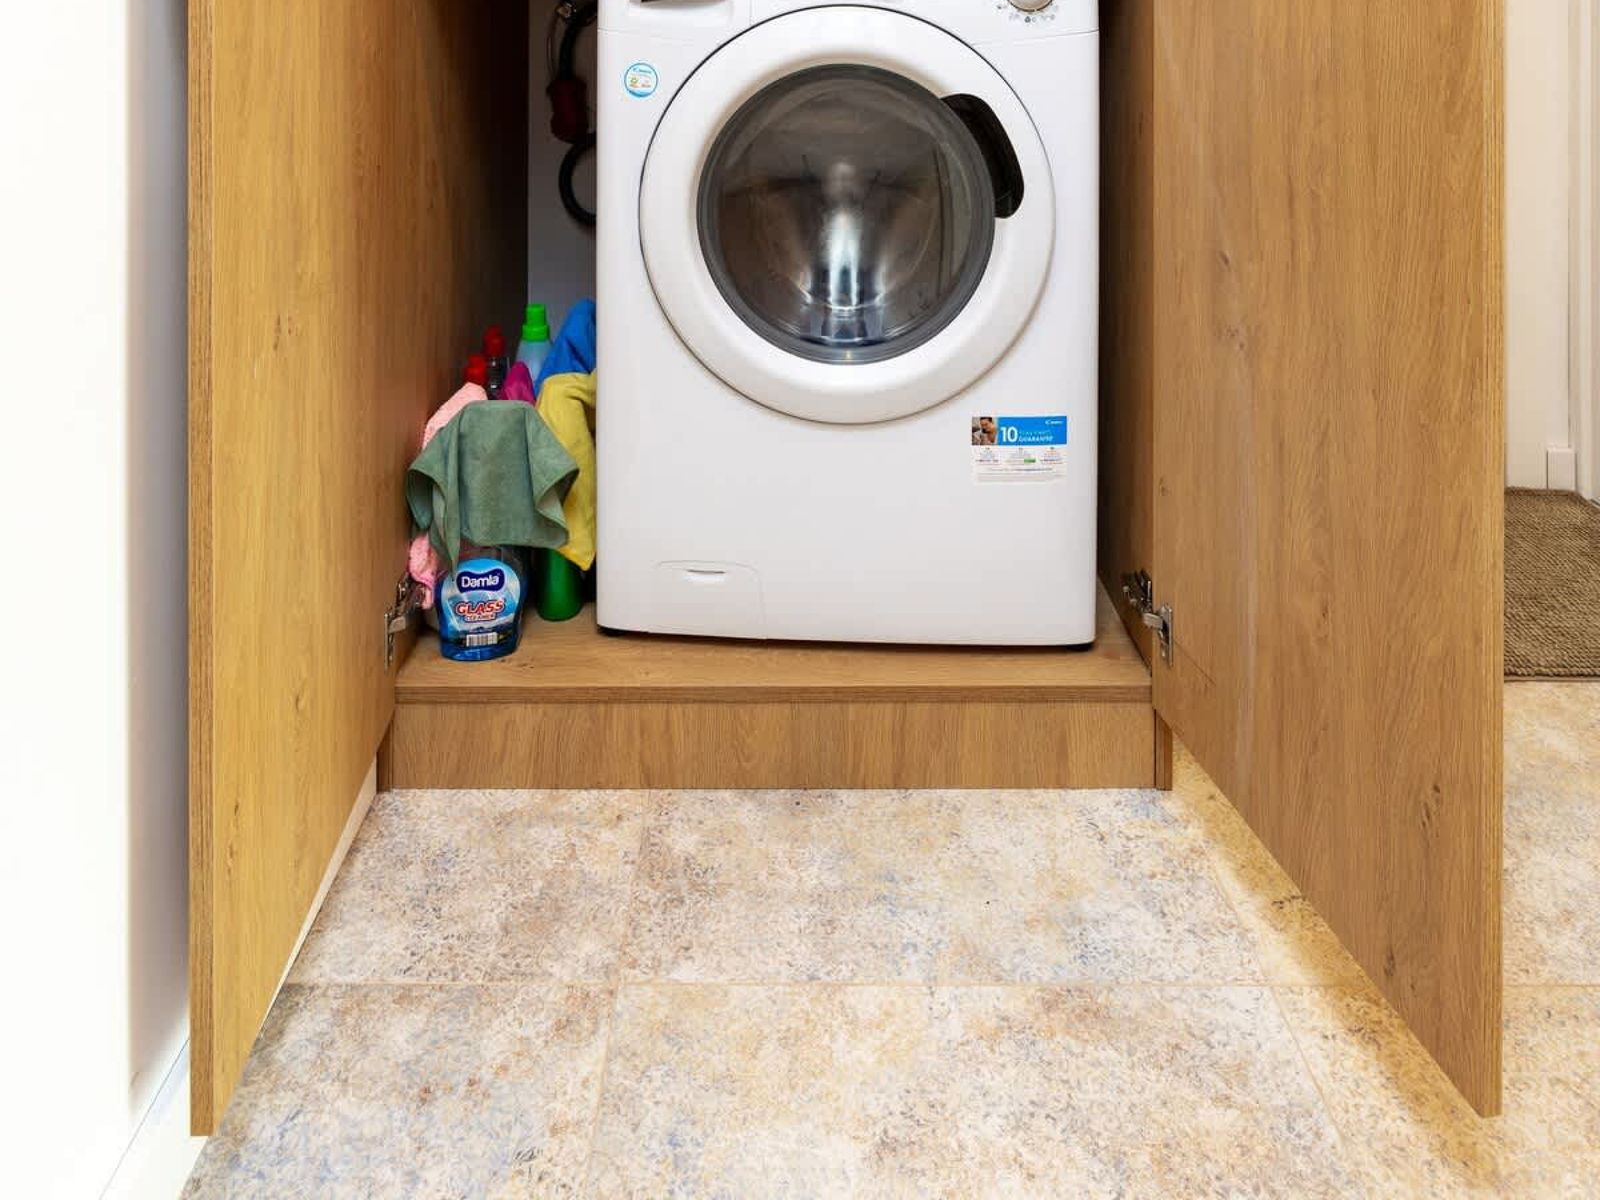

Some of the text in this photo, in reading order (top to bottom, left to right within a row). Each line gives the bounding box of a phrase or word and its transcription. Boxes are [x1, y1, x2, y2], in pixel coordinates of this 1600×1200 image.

[1000, 426, 1018, 442] 10
[461, 574, 500, 588] Damla
[456, 599, 505, 616] GLASS
